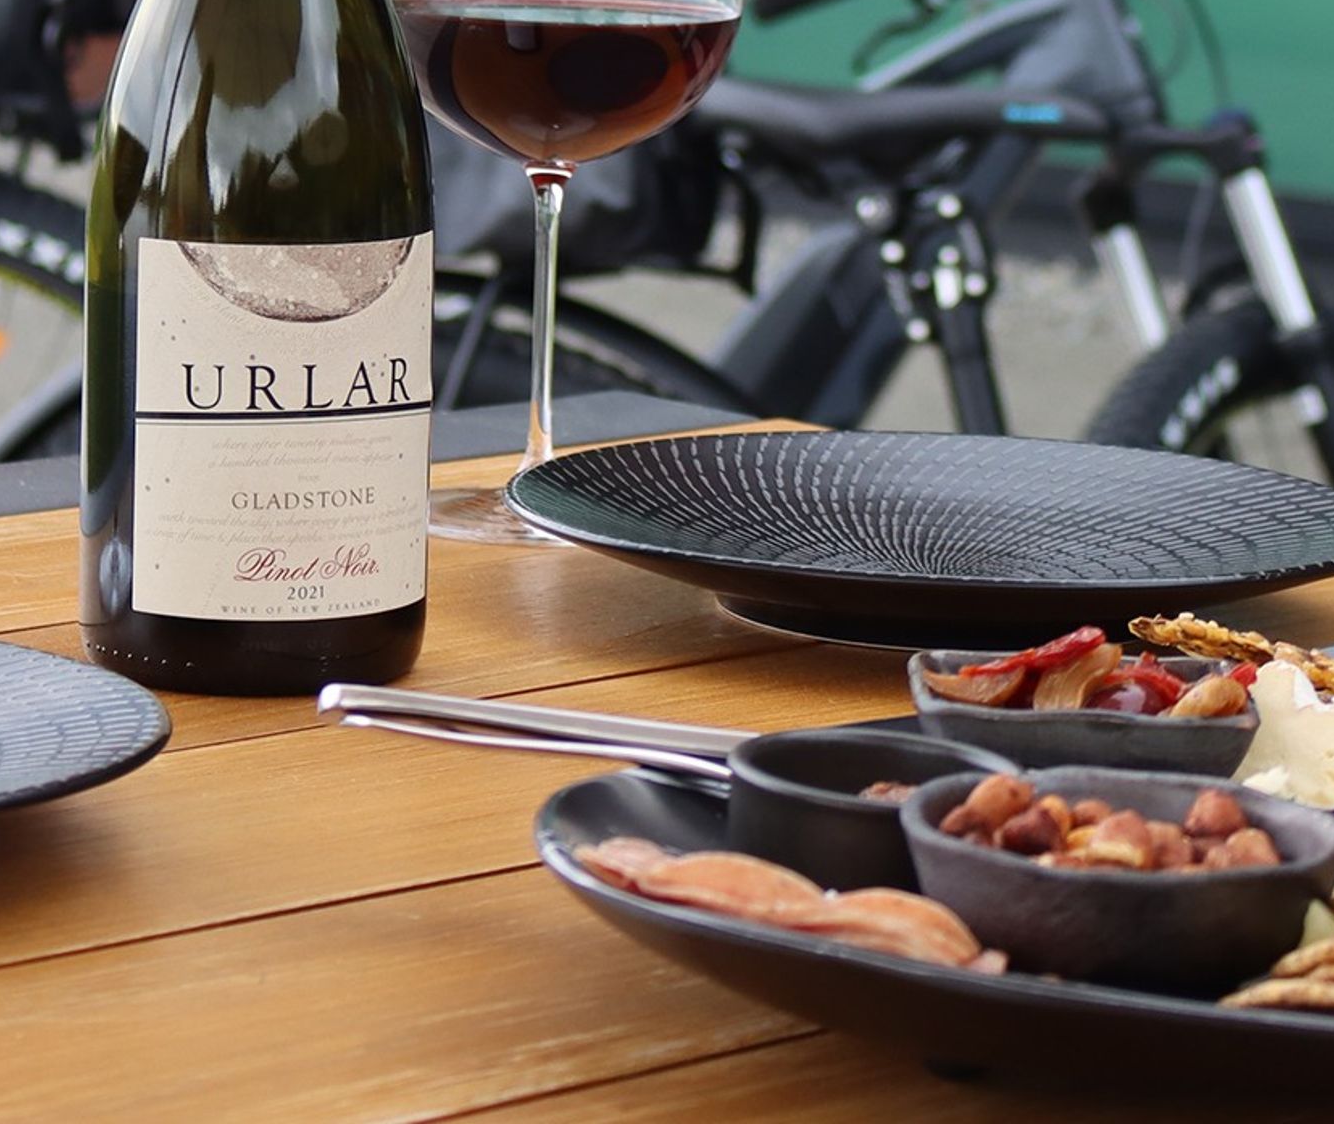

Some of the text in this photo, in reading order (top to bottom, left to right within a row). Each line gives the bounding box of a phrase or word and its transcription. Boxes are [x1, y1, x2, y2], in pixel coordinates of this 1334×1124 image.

[181, 357, 411, 410] URLAR
[231, 486, 375, 511] GLADSTONE
[233, 547, 319, 582] Pinot
[287, 585, 325, 600] 2021
[221, 598, 381, 615] WINE OF NEW ZEALAND
